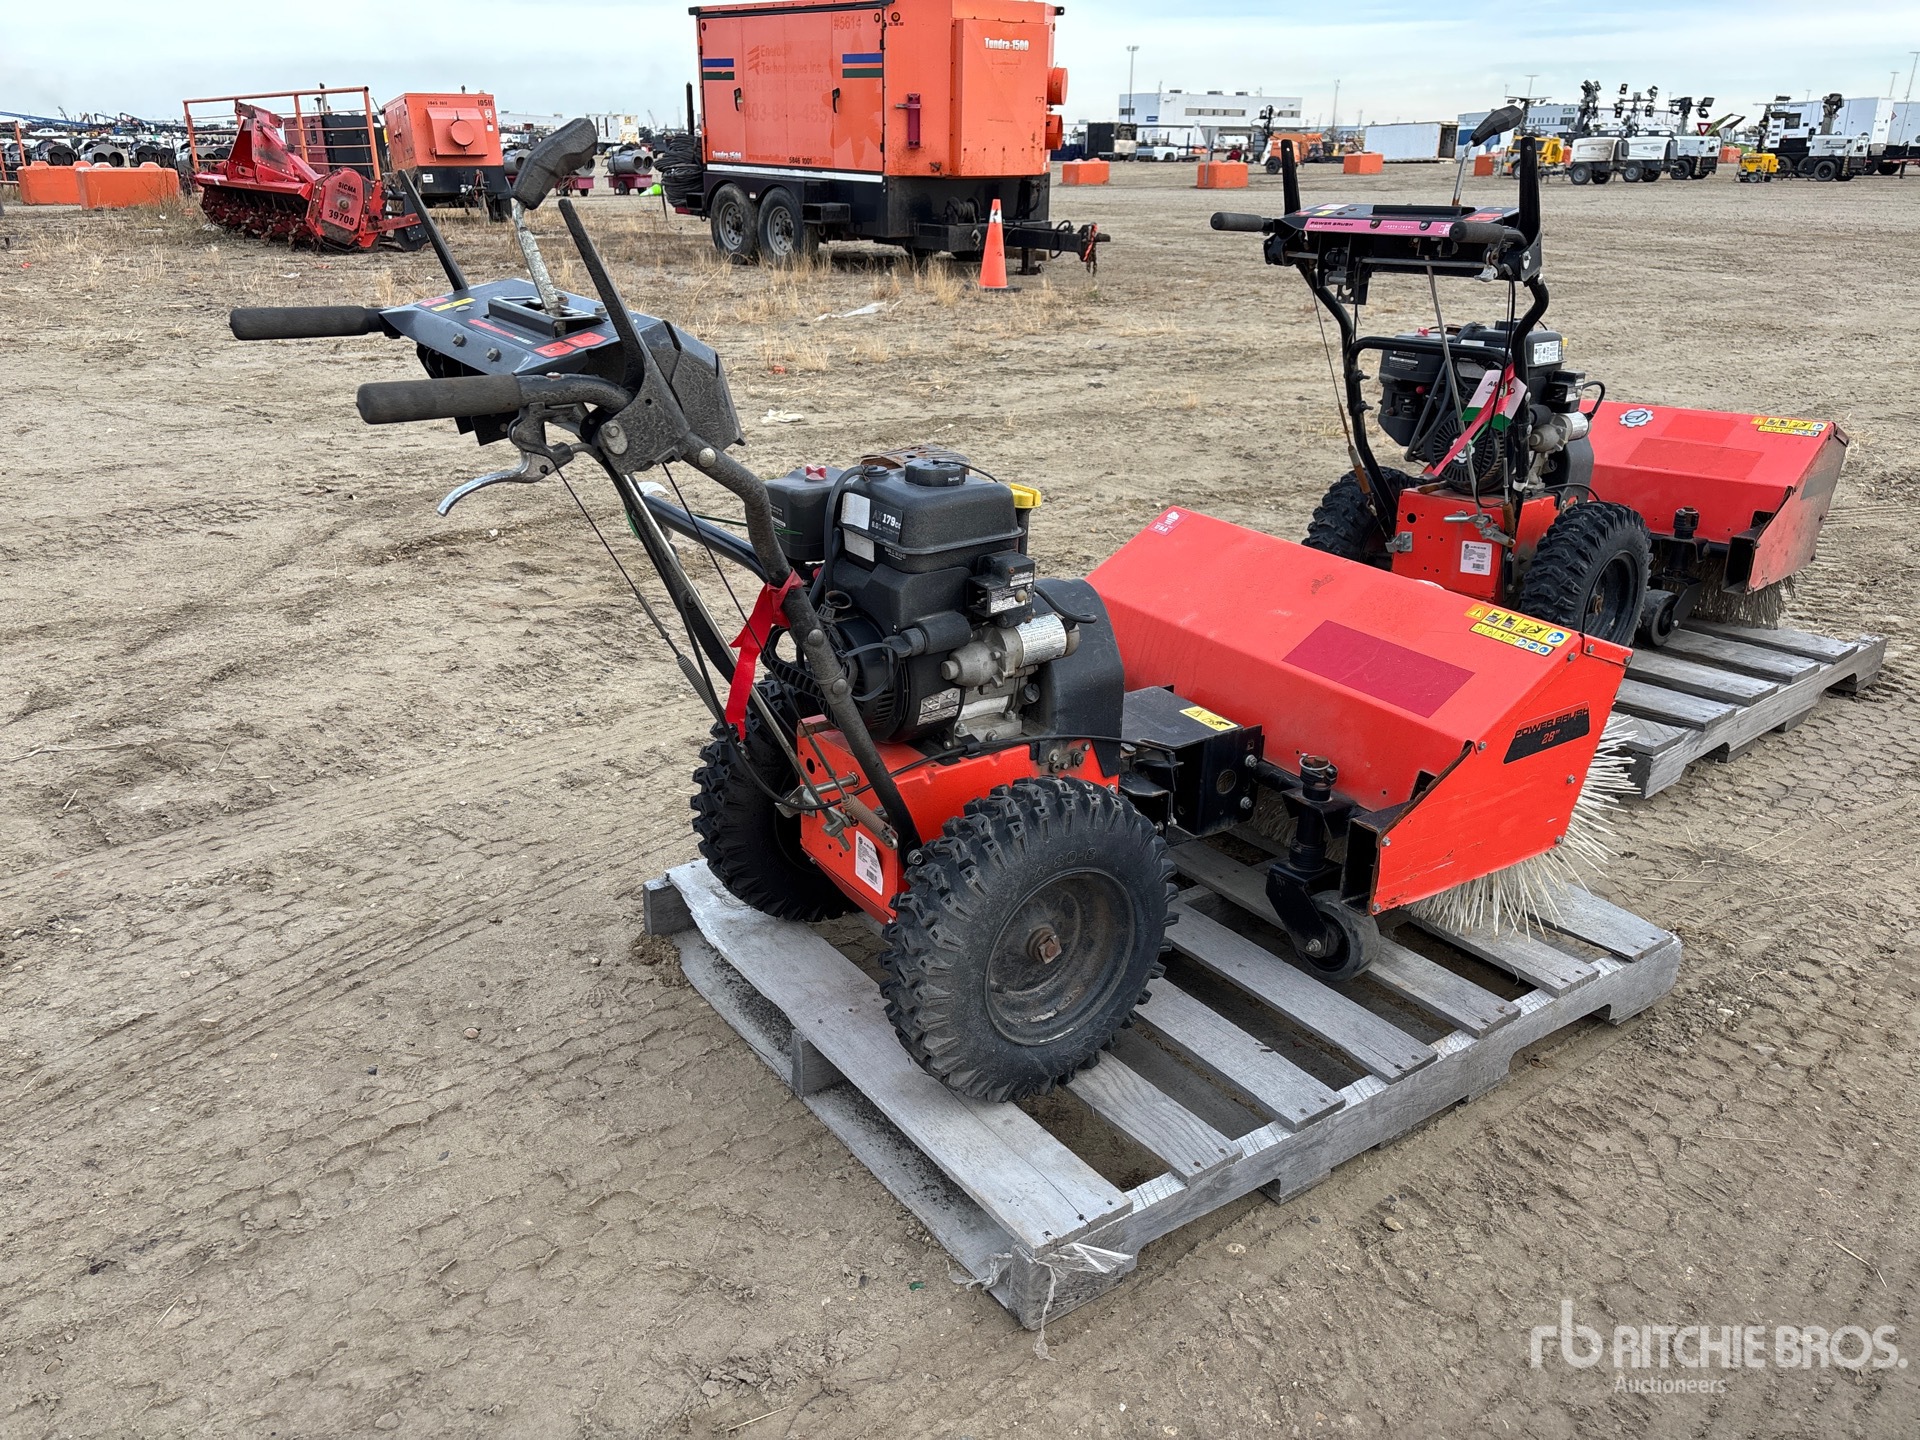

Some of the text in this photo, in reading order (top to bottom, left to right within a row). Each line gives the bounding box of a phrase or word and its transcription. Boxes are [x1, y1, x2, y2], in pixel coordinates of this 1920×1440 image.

[984, 37, 1029, 51] Tundra-1500
[477, 99, 493, 107] 10511
[711, 150, 742, 161] Tundra-1500
[338, 181, 357, 194] SICMA
[328, 209, 355, 226] 39708
[1514, 707, 1589, 739] POWER BRUSH
